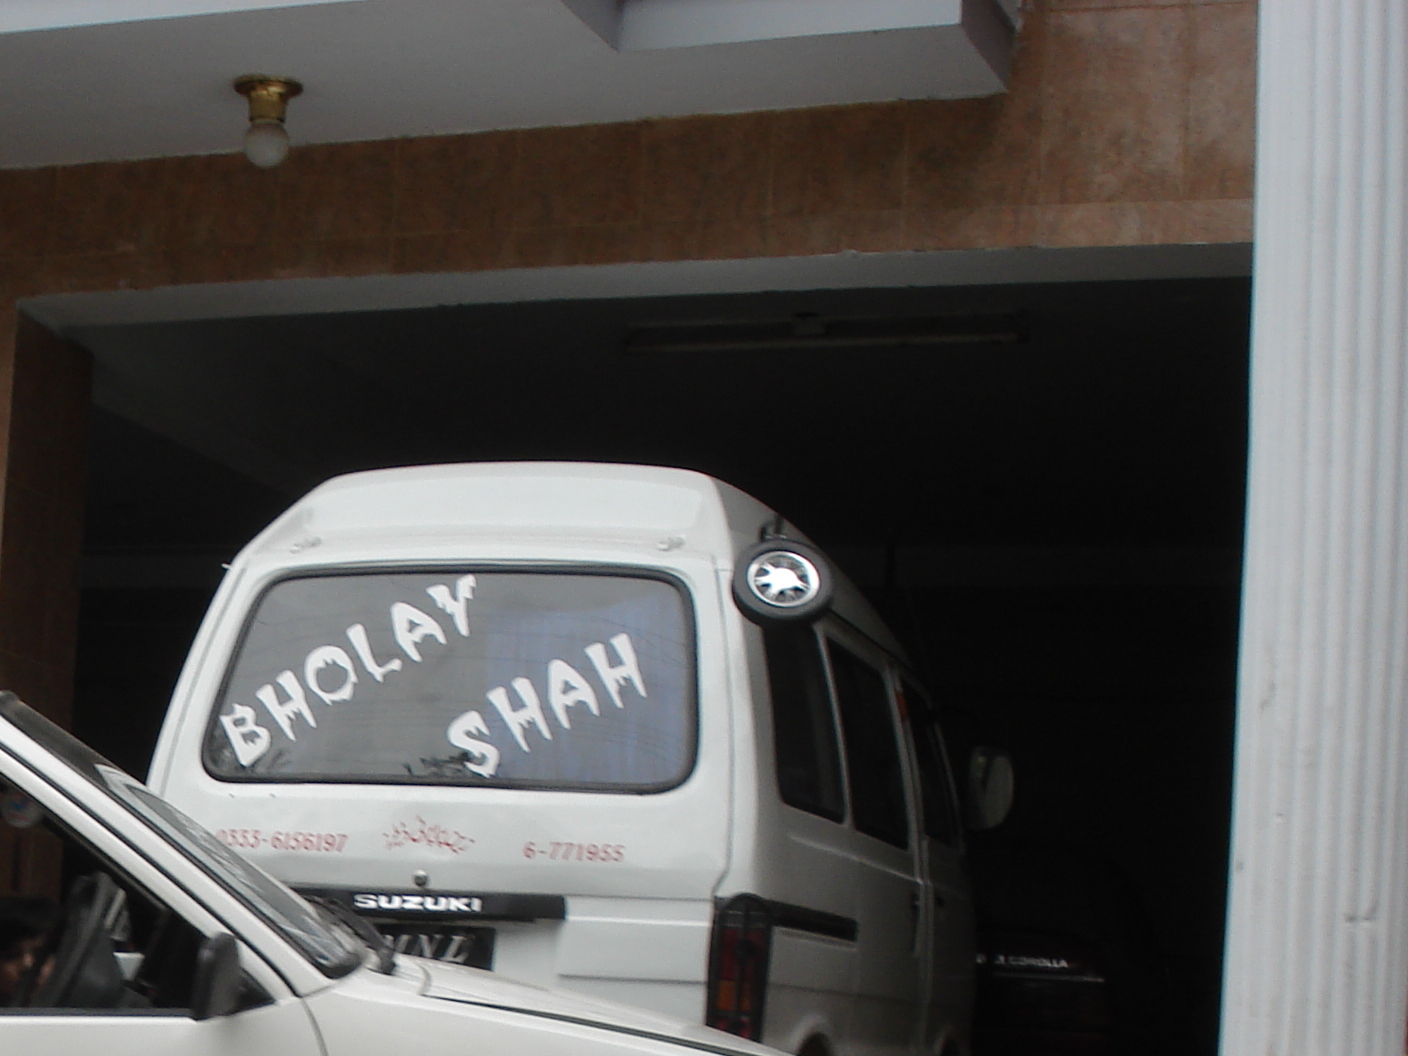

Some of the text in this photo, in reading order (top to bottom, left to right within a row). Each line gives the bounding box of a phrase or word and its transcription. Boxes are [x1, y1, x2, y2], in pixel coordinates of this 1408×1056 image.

[219, 574, 476, 767] BHOLAY
[447, 633, 647, 778] SHAH
[354, 893, 482, 912] SUZUKI
